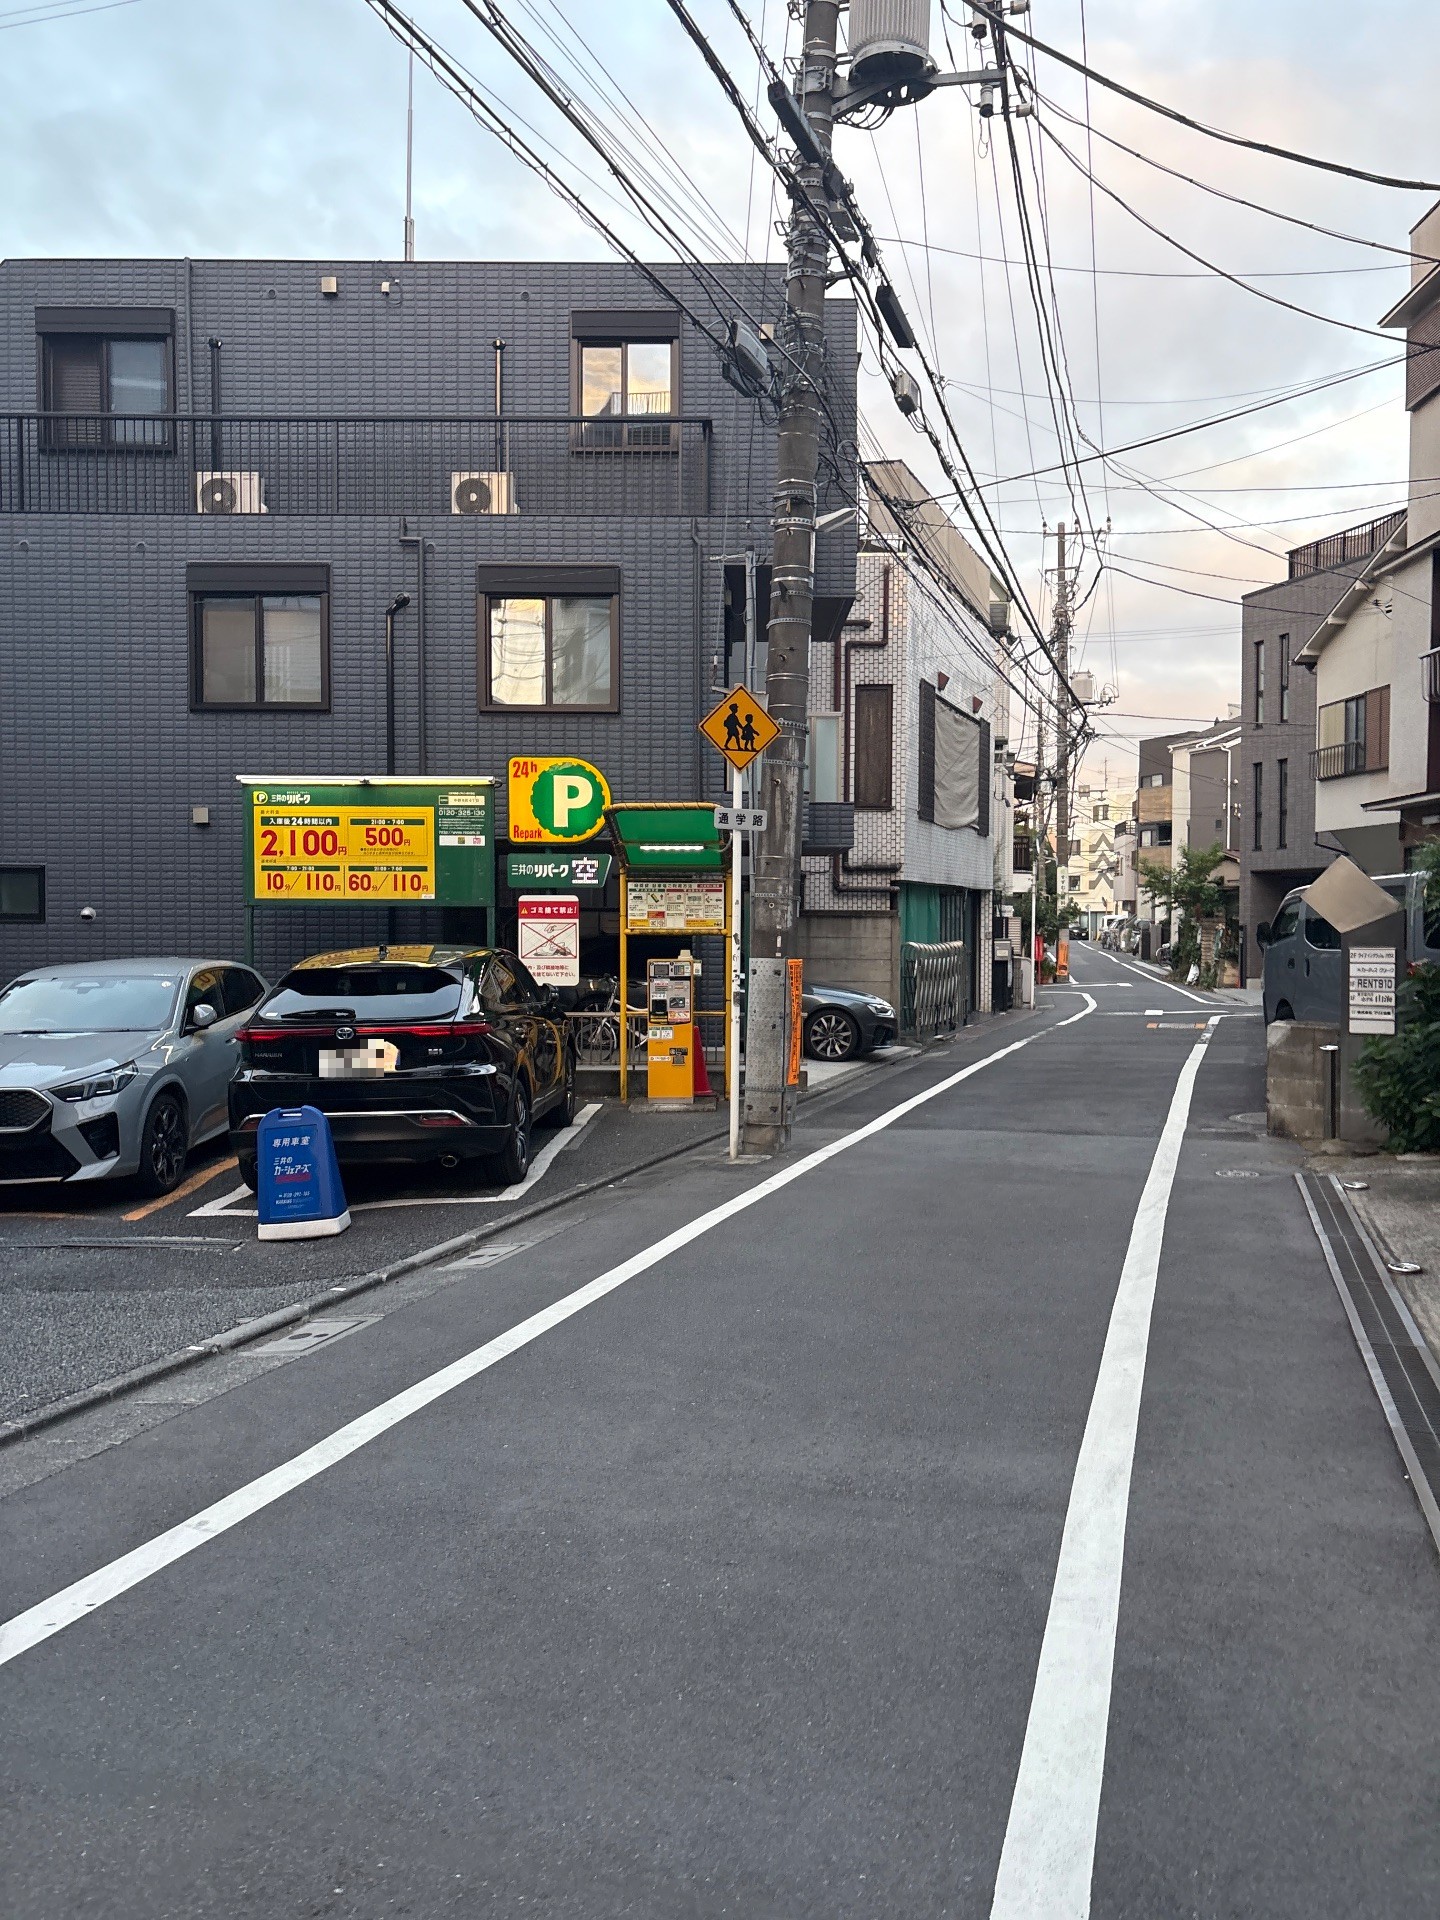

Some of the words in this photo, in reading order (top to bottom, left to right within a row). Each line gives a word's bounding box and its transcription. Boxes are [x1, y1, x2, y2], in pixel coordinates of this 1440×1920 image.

[513, 761, 537, 778] 24h
[271, 794, 310, 804] 三井のリパーク
[553, 775, 593, 828] P
[268, 817, 333, 826] 入庫後24時間以内
[718, 812, 763, 827] 通学路
[365, 827, 411, 847] 500円
[513, 825, 543, 841] Repark
[260, 829, 347, 857] 2,100円
[511, 863, 569, 878] 三井のリパーク
[571, 857, 599, 885] 空
[273, 1136, 311, 1147] 専用車室
[273, 1157, 293, 1166] 三井の
